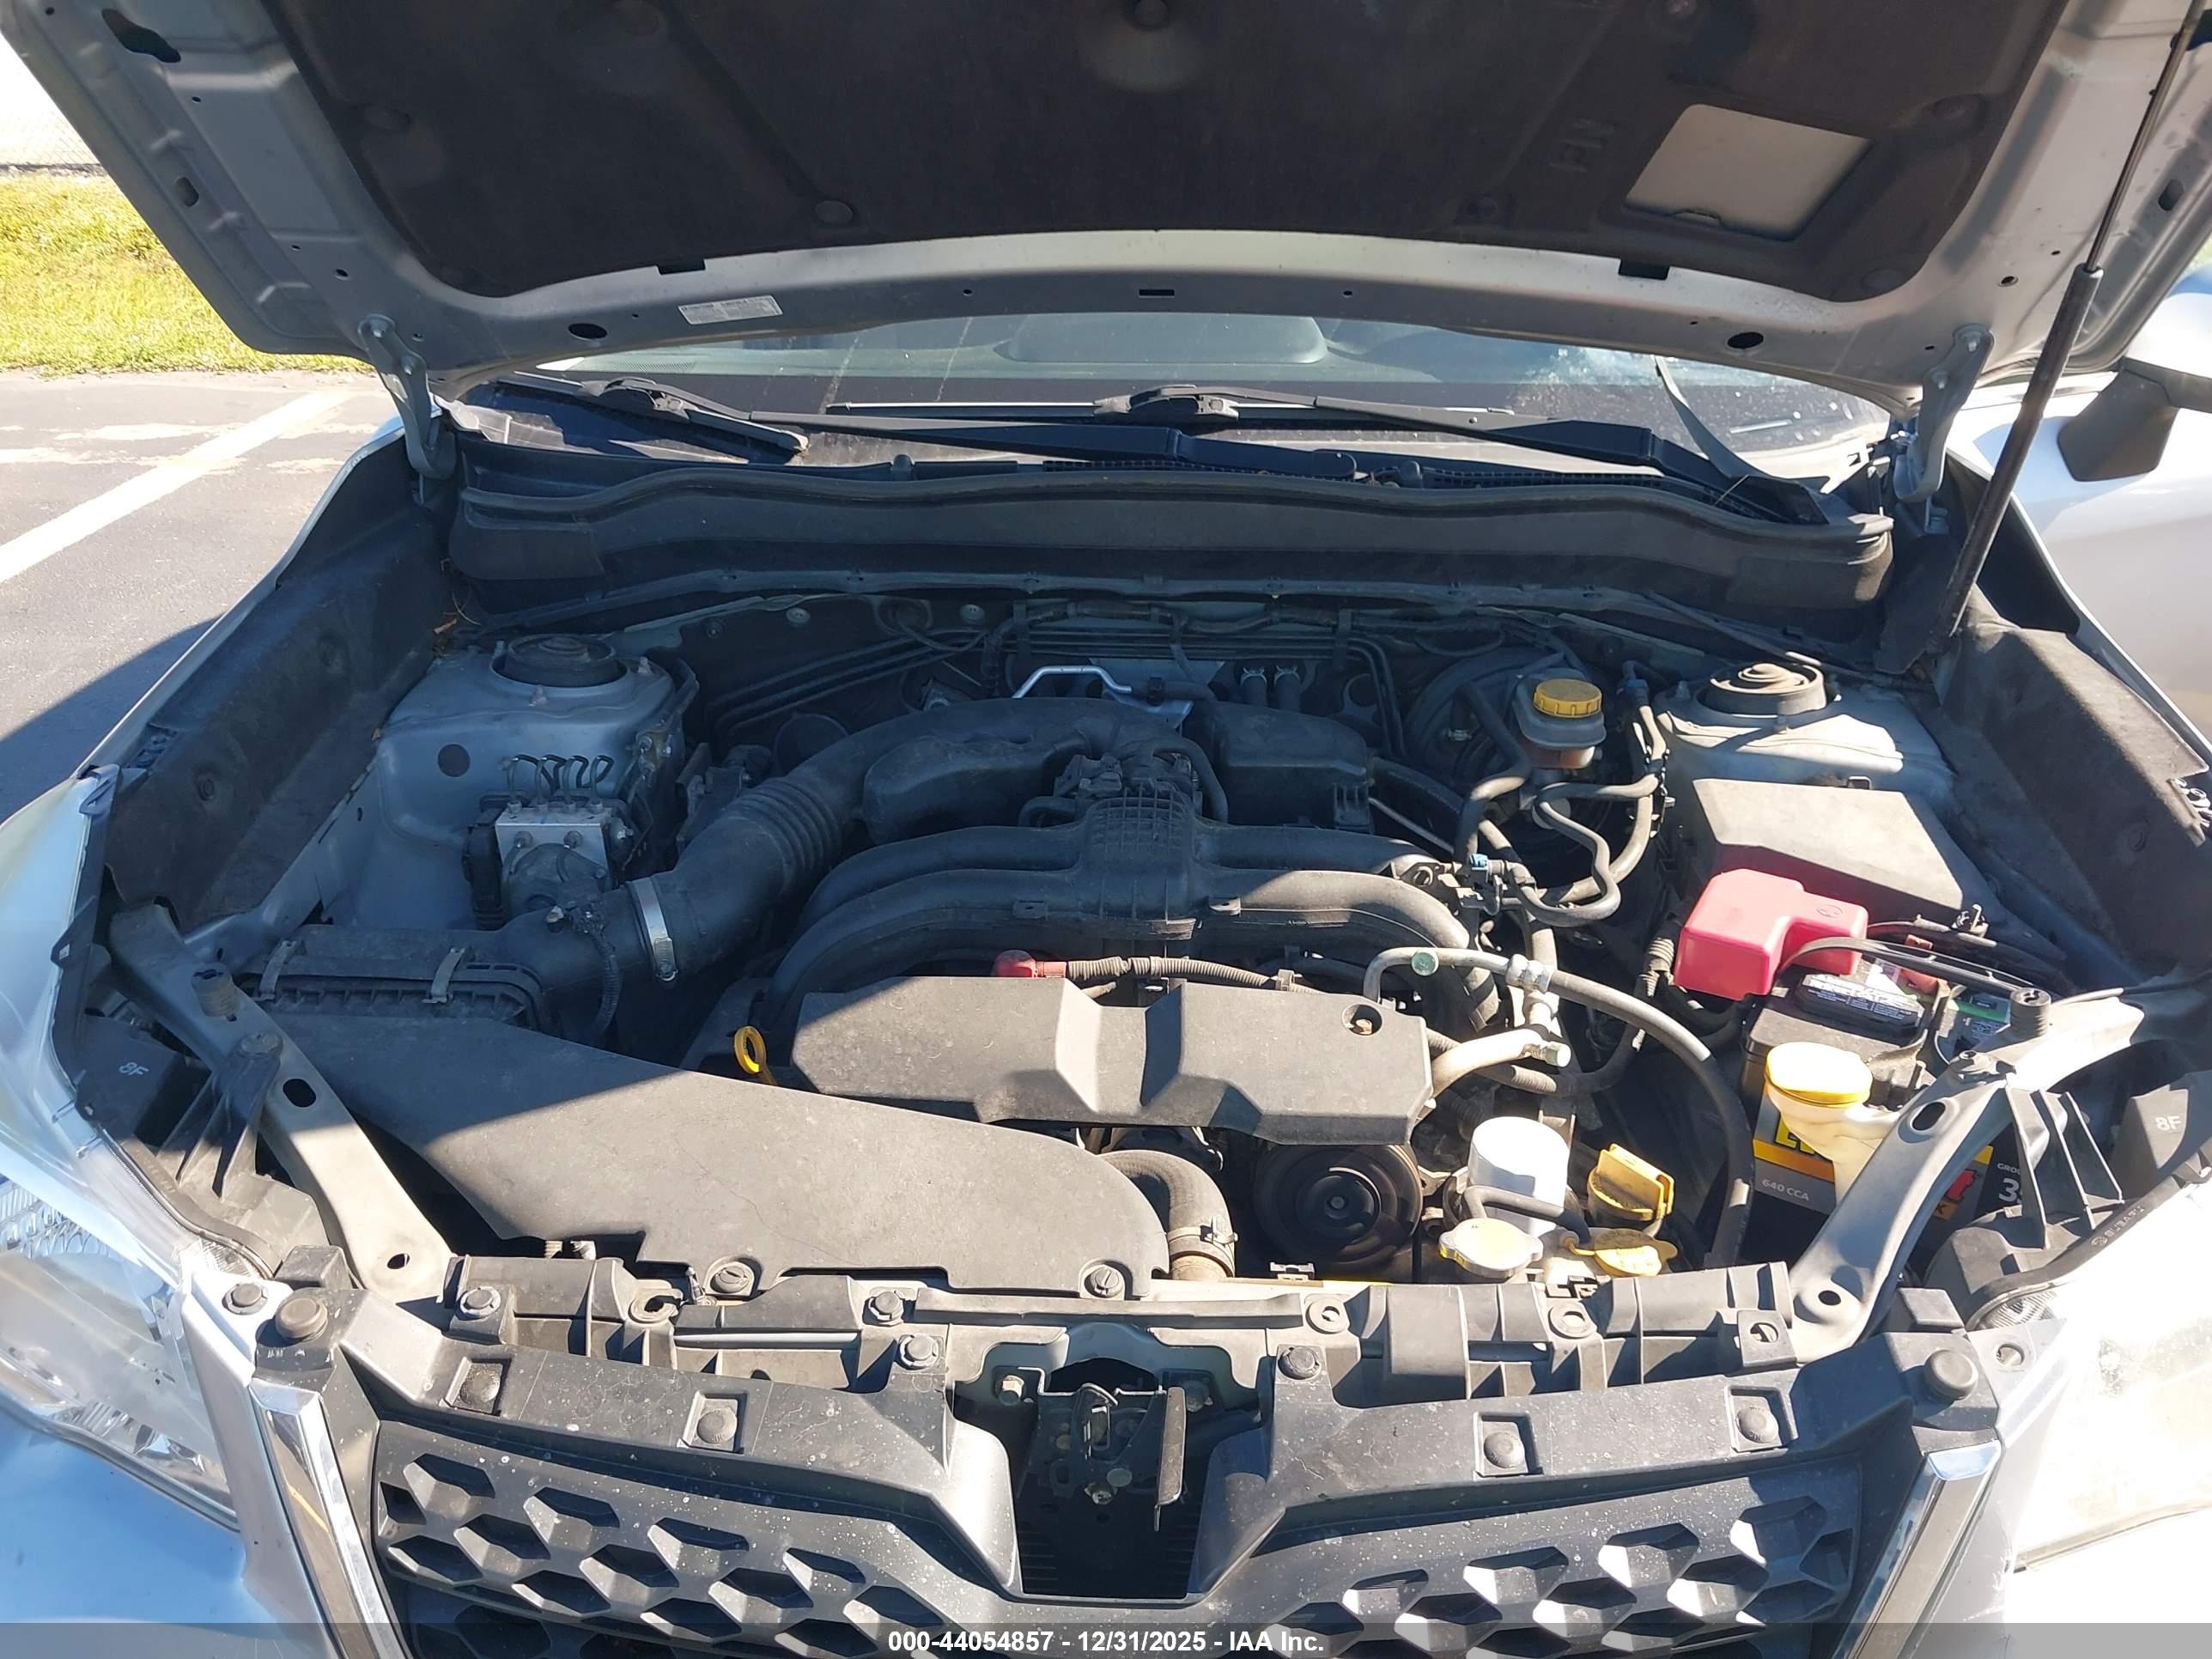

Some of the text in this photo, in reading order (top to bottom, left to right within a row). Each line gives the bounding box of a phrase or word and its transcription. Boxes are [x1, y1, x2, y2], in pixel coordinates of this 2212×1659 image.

[119, 1061, 149, 1076] 8F
[2155, 1115, 2182, 1132] 8F
[1761, 1178, 1809, 1201] 640 CCA
